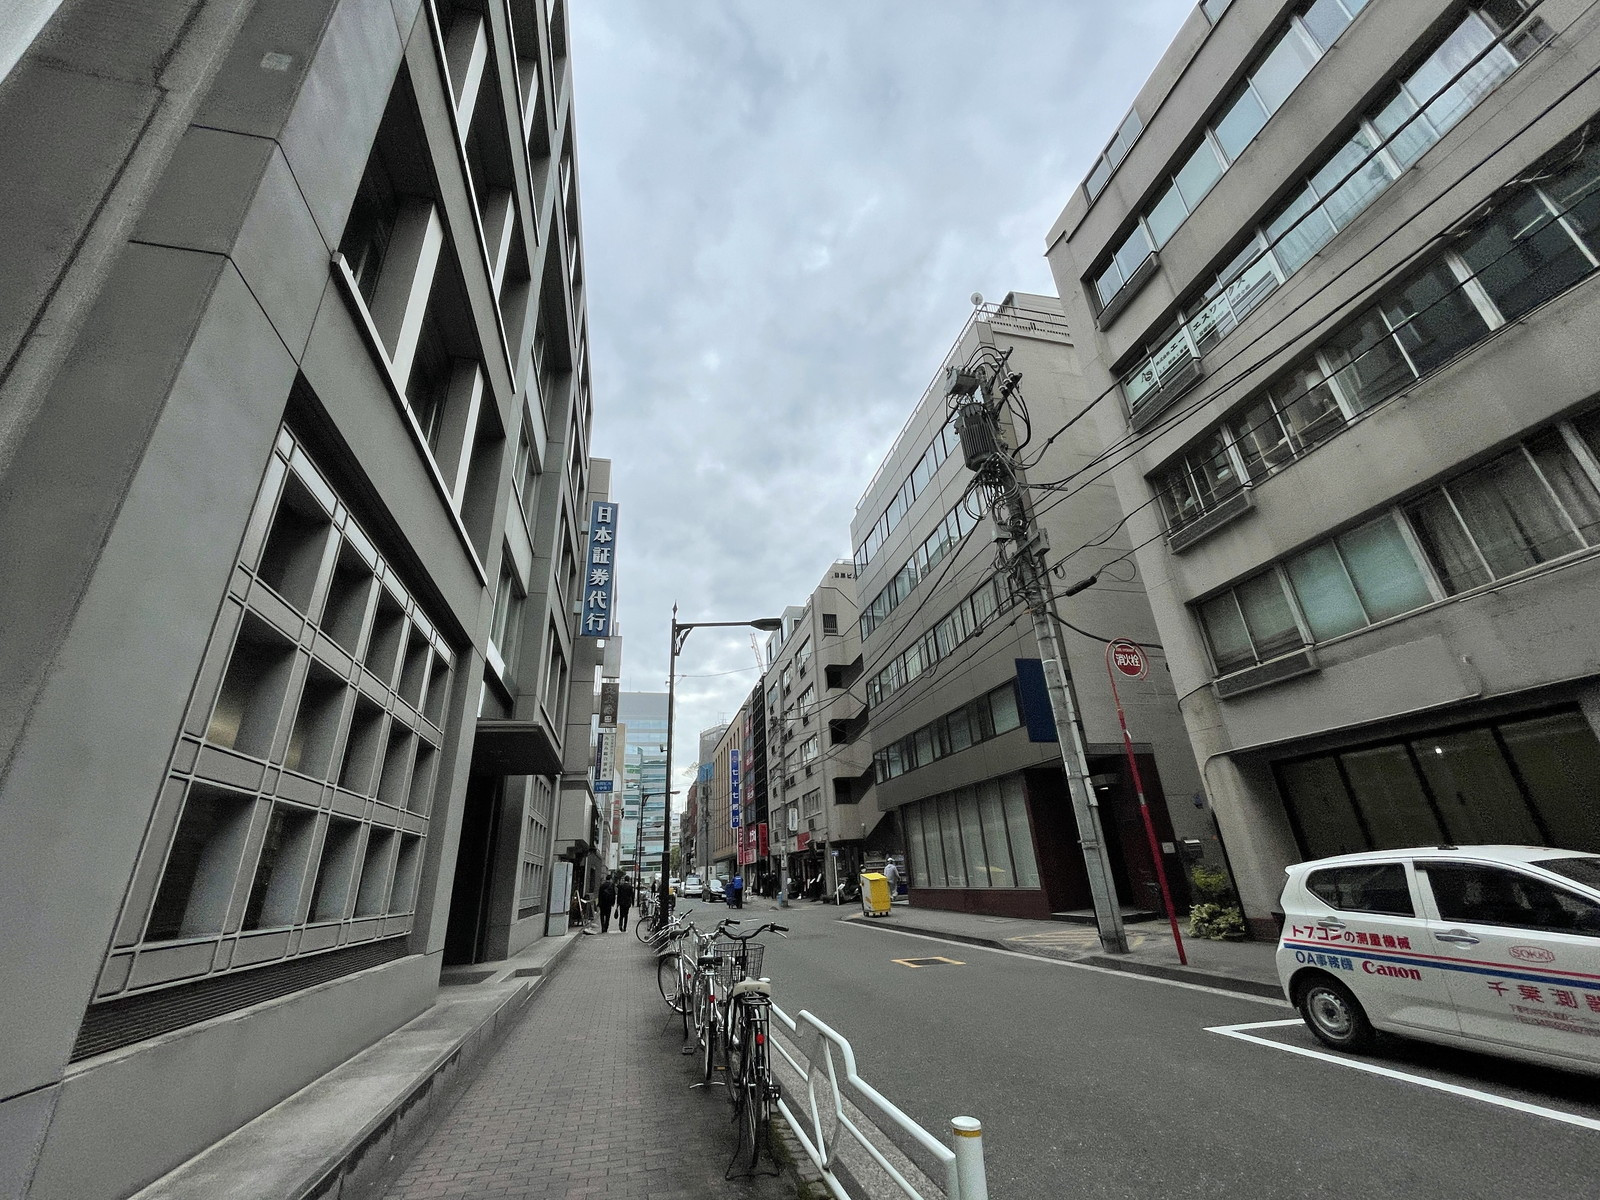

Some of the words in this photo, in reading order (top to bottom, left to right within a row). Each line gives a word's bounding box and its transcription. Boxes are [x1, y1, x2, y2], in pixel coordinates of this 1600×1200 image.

[586, 506, 613, 632] 日本証券代行
[1115, 653, 1140, 666] 消火栓
[1296, 951, 1354, 971] OA事務機
[1362, 960, 1422, 981] Canon
